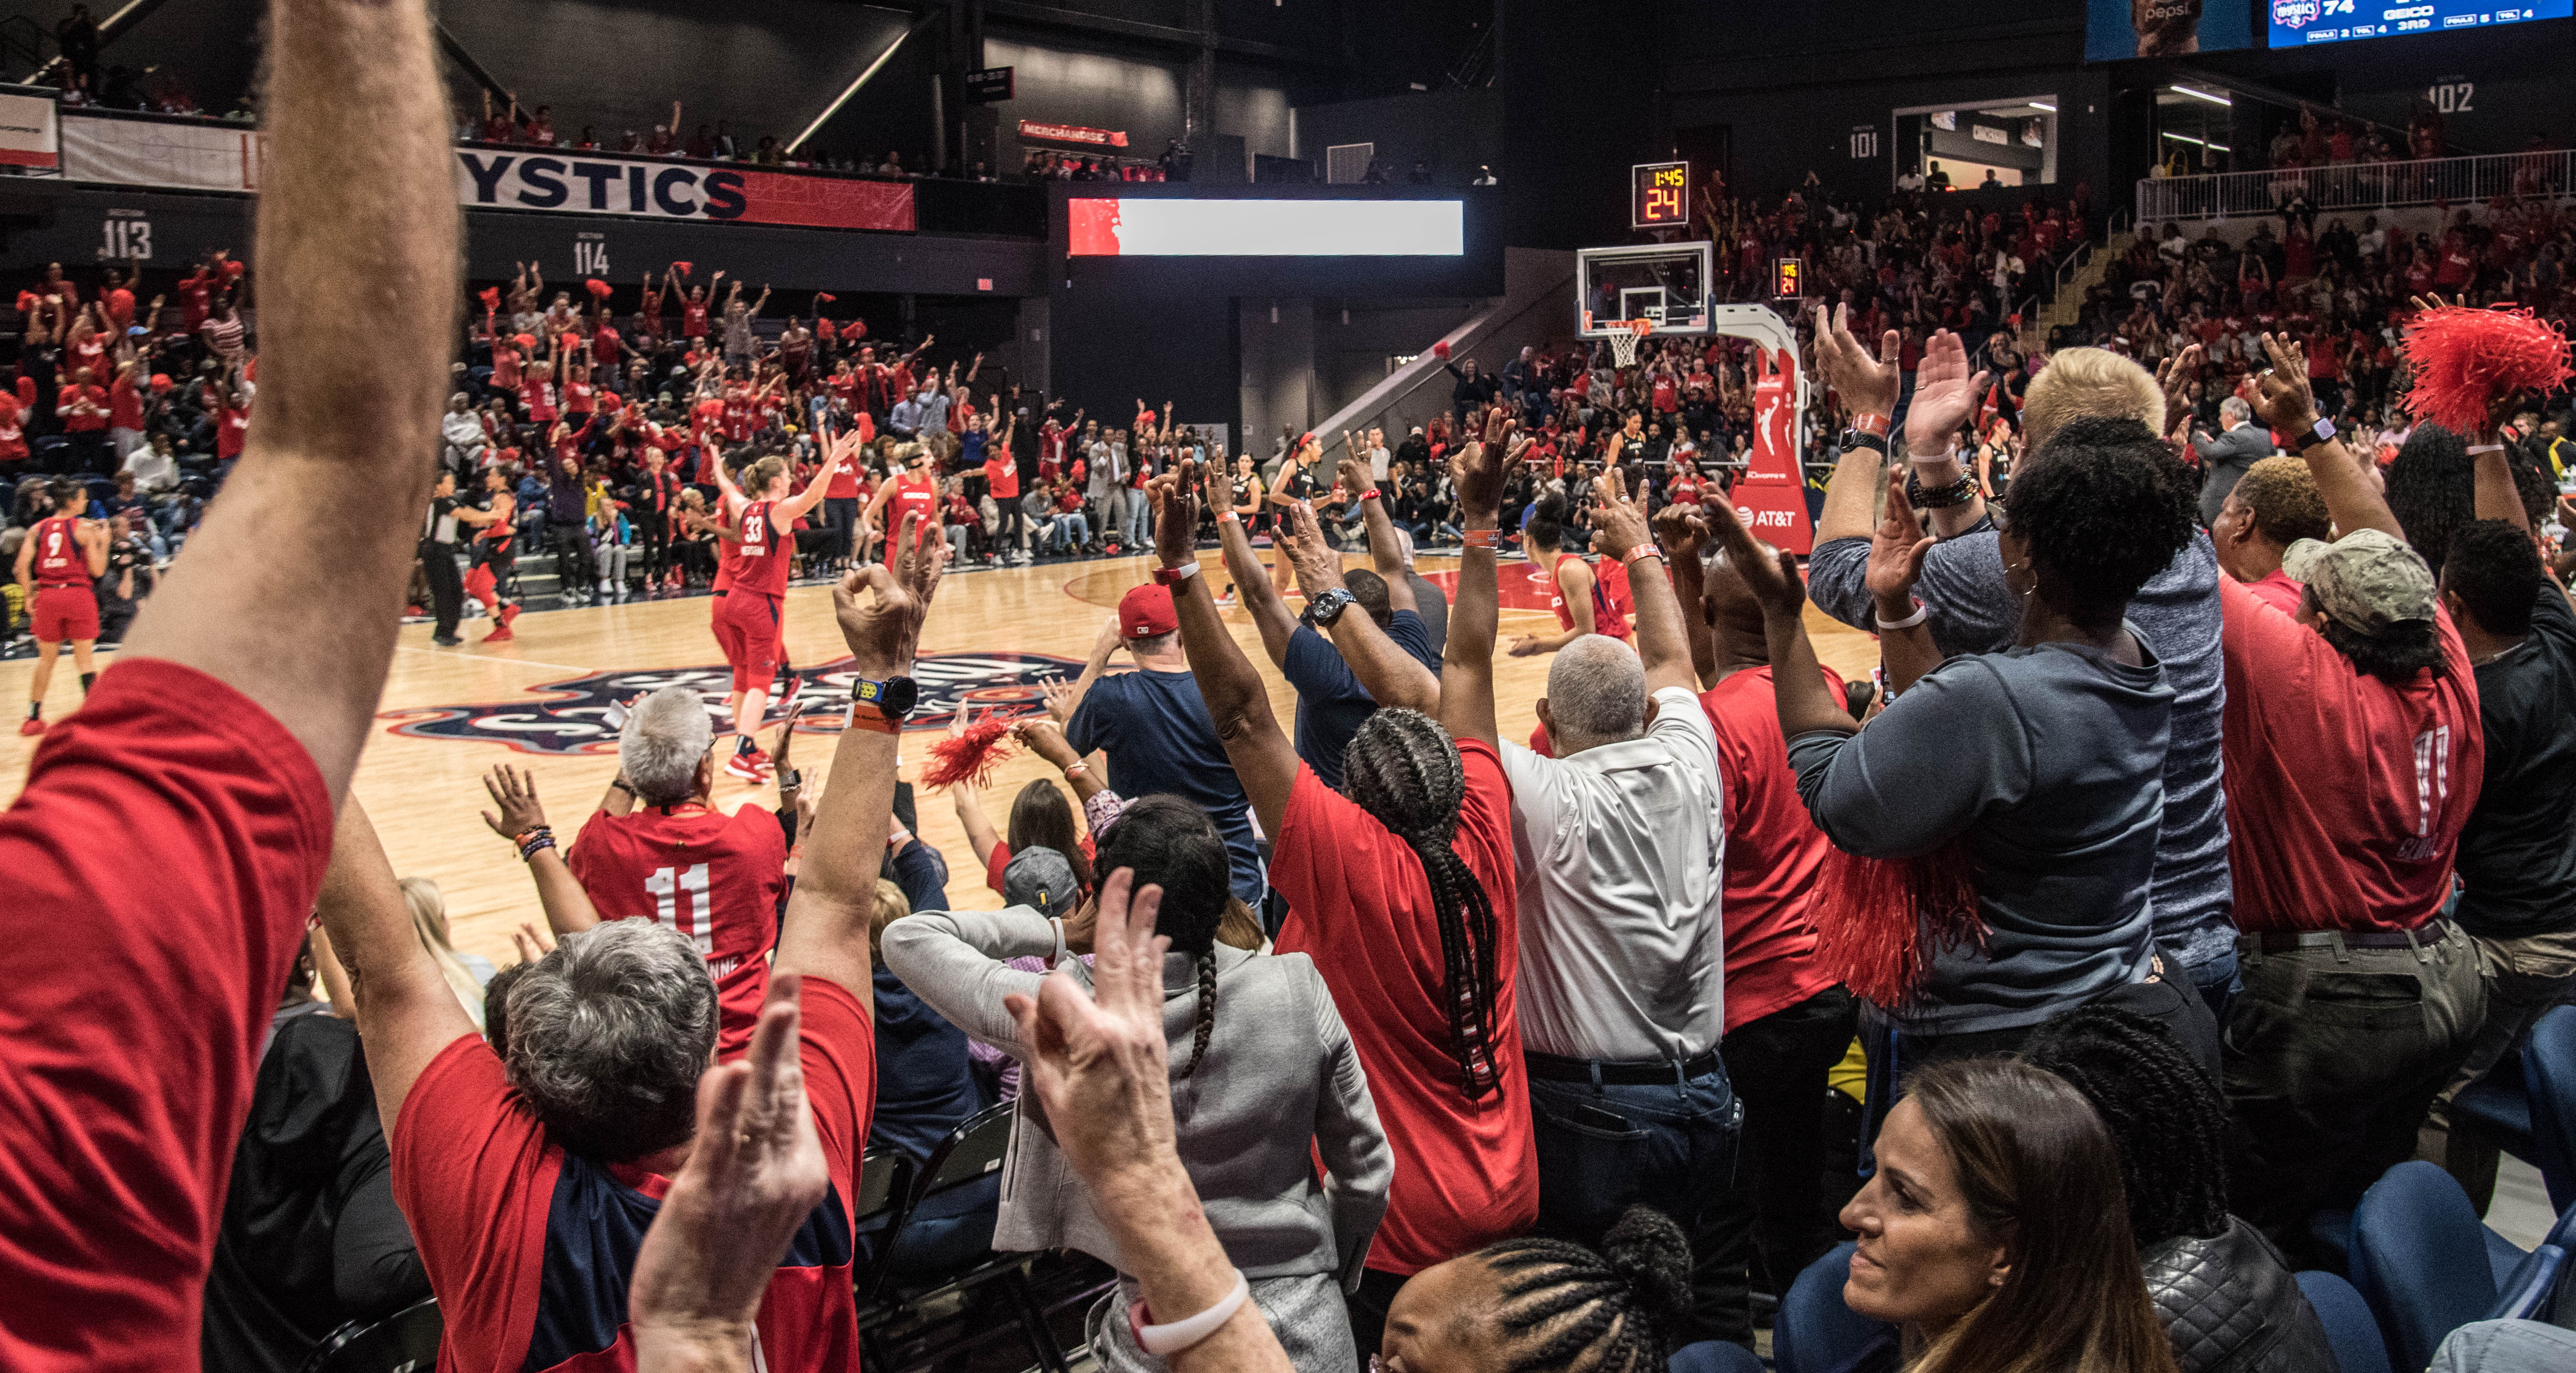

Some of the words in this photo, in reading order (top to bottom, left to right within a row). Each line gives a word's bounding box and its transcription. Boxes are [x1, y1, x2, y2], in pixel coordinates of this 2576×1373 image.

[2323, 0, 2354, 15] 74
[2384, 5, 2434, 21] GEICO
[2340, 29, 2350, 38] 2
[2377, 25, 2387, 33] 4
[2398, 19, 2431, 31] 3RD
[2428, 83, 2474, 113] 102
[1024, 124, 1105, 142] MERCHANDISE
[1850, 132, 1877, 159] 101
[457, 152, 747, 221] YSTICS
[1655, 169, 1684, 187] 1:45
[1646, 188, 1679, 219] 24
[103, 220, 153, 259] 113
[574, 241, 610, 276] 114
[1781, 277, 1795, 294] 24
[745, 515, 763, 543] 33
[1756, 510, 1795, 527] AT&T
[48, 532, 63, 557] 9
[645, 863, 714, 955] 11
